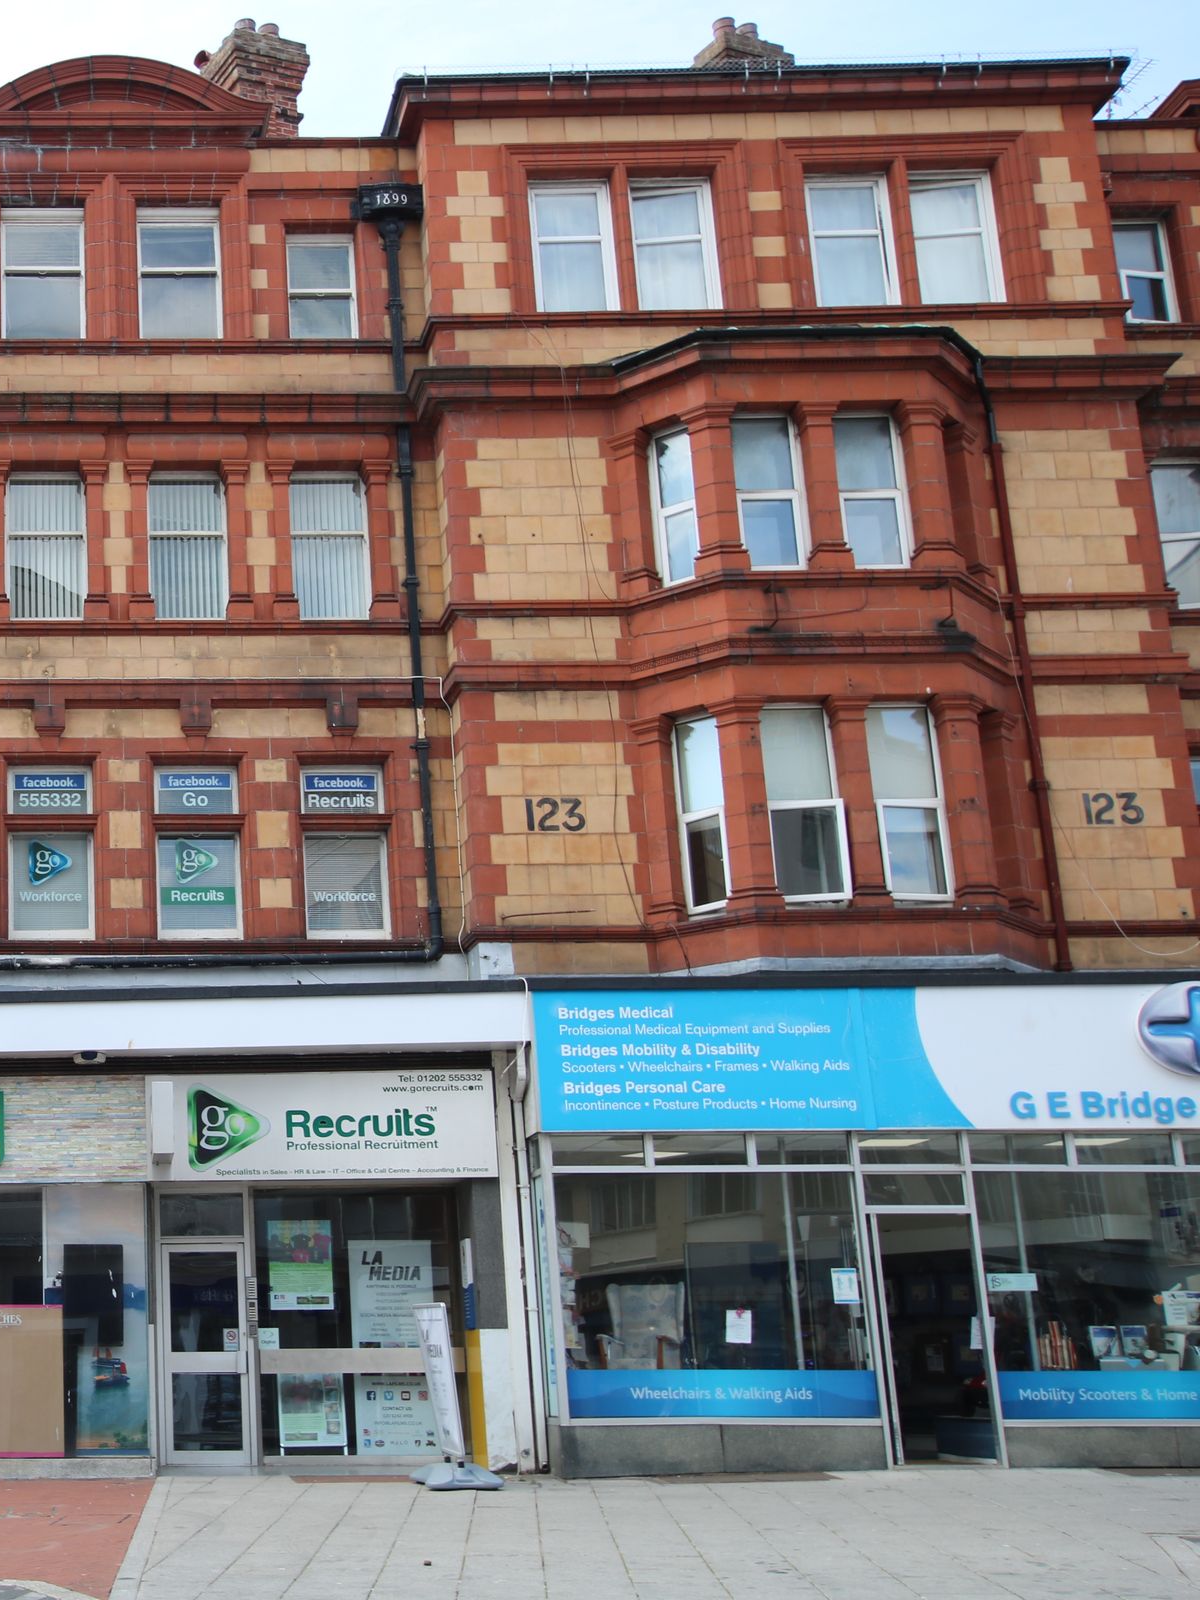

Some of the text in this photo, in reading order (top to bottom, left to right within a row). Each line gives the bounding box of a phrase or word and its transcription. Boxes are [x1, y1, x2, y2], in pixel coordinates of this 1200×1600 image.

[375, 192, 408, 205] 1899
[22, 776, 74, 788] facebook
[167, 775, 220, 787] facebook
[313, 776, 364, 788] facebook
[18, 793, 81, 807] 555332
[182, 792, 209, 807] Go
[307, 793, 375, 808] Recruits
[524, 797, 586, 833] 123
[1080, 791, 1146, 827] 123
[19, 890, 82, 902] Workforce
[170, 889, 225, 902] Recruits
[312, 890, 377, 902] Workforce
[557, 1006, 673, 1022] Bridges Medical
[558, 1022, 831, 1037] Professional Medical Equipment and Supplies
[560, 1042, 760, 1059] Bridges Mobility & Disability
[561, 1059, 850, 1074] Scooters Wheelchairs Frames Walking Aids
[398, 1073, 483, 1083] Tel: 01202 555332
[382, 1083, 484, 1094] www.gorecruits.com
[563, 1080, 726, 1096] Bridges Personal Care
[564, 1097, 857, 1112] Incontinence Posture Products Home Nursing
[1009, 1090, 1037, 1120] G
[1046, 1091, 1072, 1119] E
[199, 1104, 247, 1151] go
[285, 1108, 436, 1139] Recruits
[286, 1138, 439, 1152] Professional Recruitment
[215, 1168, 261, 1176] Specialists
[361, 1250, 383, 1266] LA
[368, 1266, 421, 1281] MEDIA
[629, 1386, 813, 1404] Wheelchairs & Walking Aids
[1018, 1388, 1198, 1405] Mobility Scooters & Home
